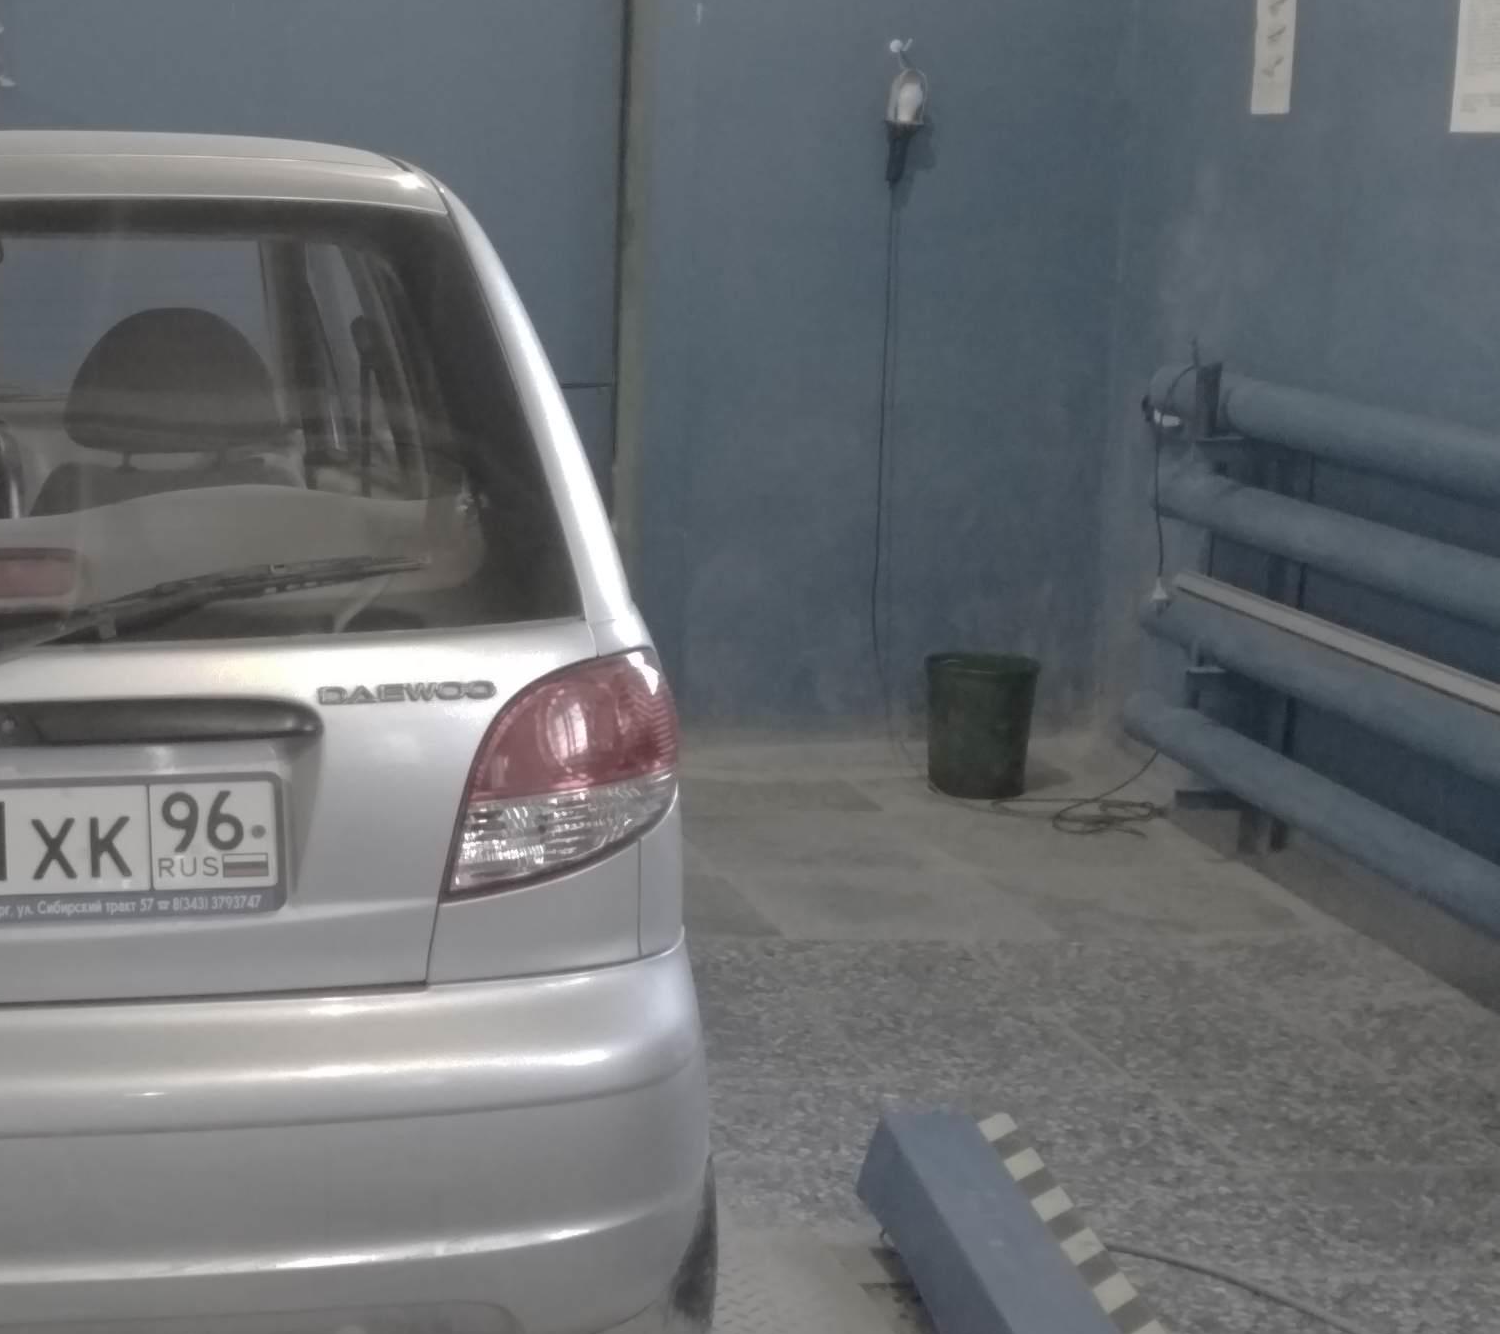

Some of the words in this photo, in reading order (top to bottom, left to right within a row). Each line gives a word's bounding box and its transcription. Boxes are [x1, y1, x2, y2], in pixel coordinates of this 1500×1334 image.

[316, 680, 498, 705] DAEWOO
[161, 790, 245, 853] 96
[157, 856, 219, 878] RUS
[37, 899, 101, 916] Сибирский
[105, 901, 137, 915] тракт
[140, 897, 154, 911] 57
[211, 895, 262, 910] 3793747
